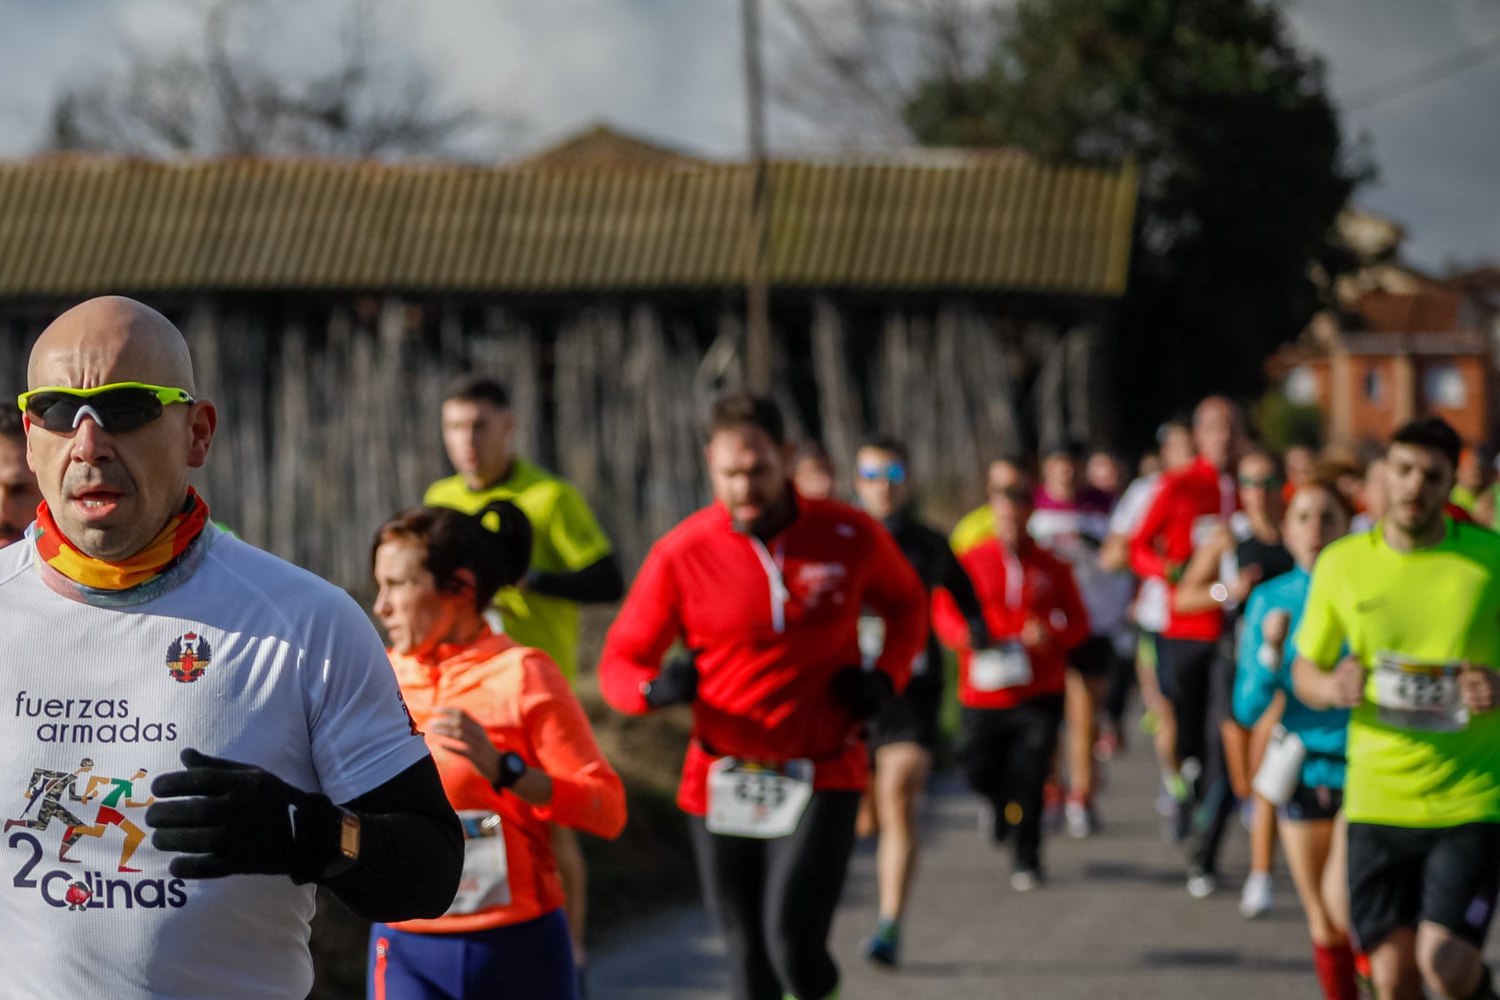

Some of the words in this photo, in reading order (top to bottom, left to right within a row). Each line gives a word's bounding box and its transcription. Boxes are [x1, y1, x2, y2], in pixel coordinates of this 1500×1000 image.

[15, 691, 129, 718] fuerzas
[36, 717, 178, 743] armadas
[8, 832, 44, 888] 2
